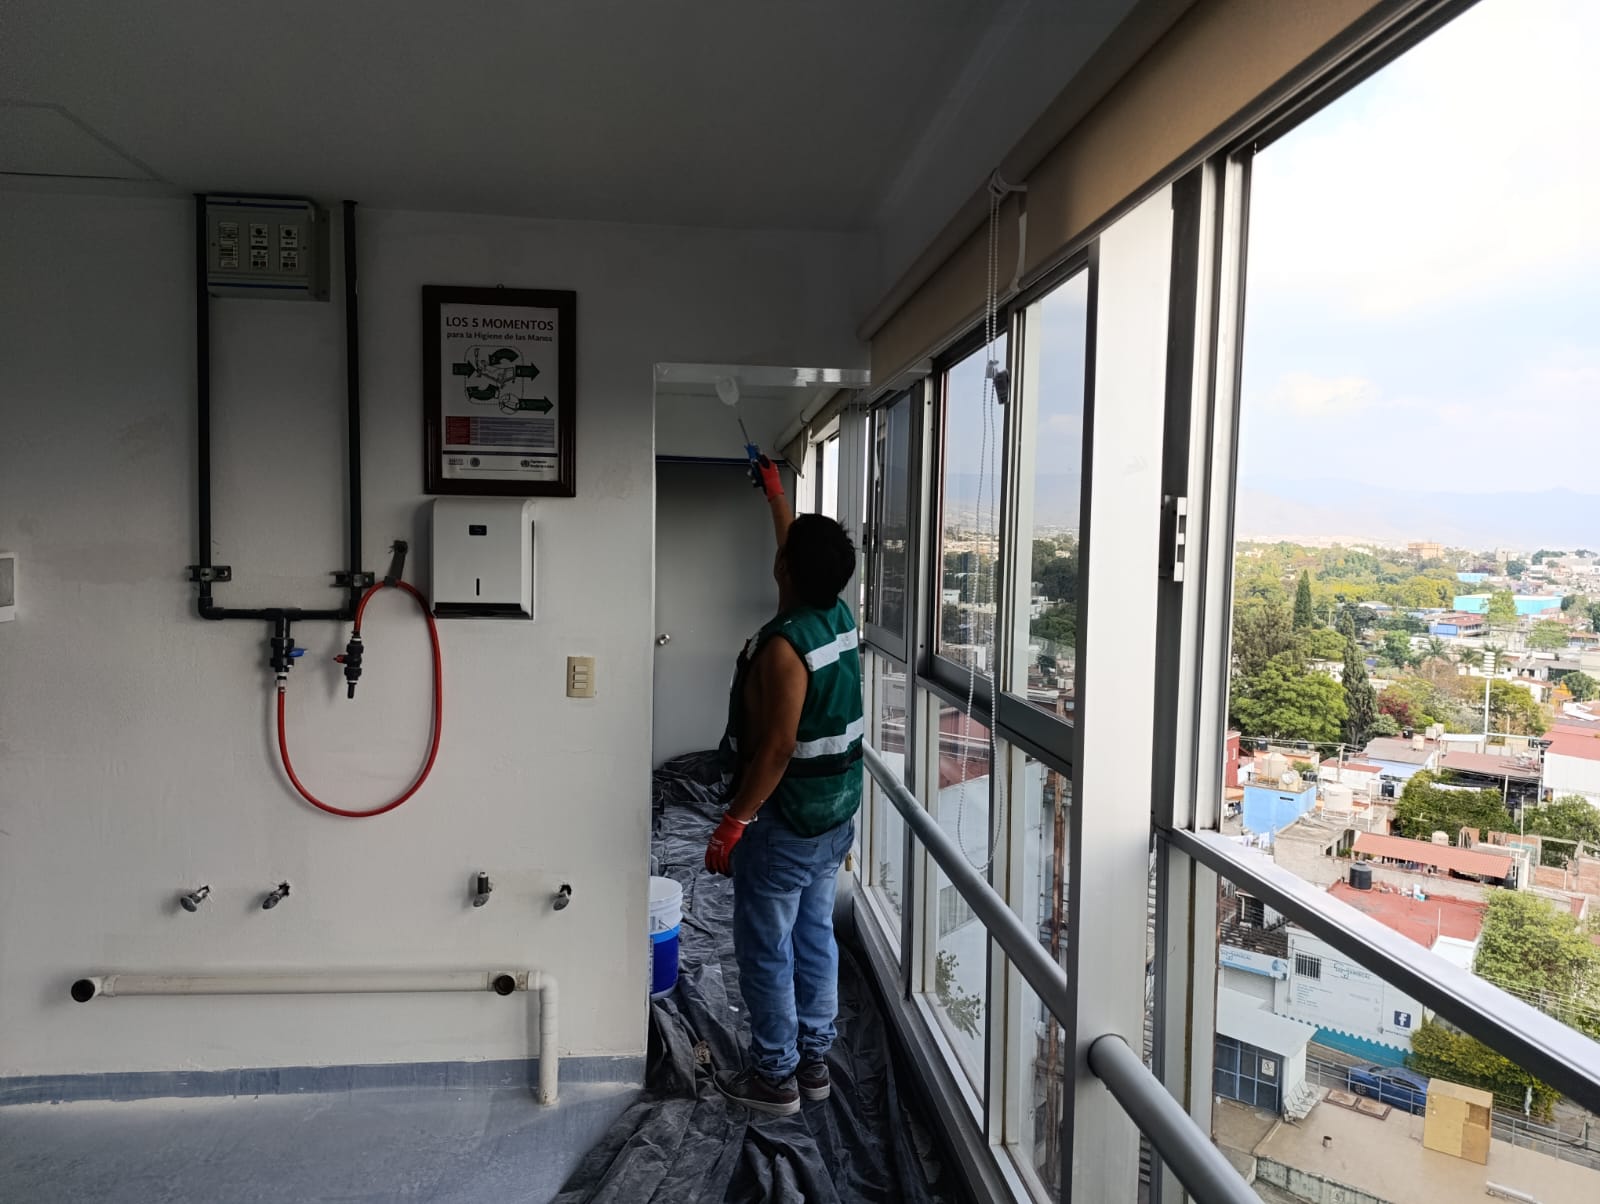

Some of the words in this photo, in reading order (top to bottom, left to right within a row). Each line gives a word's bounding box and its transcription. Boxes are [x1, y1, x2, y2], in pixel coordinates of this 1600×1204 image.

[446, 316, 468, 328] LOS
[472, 317, 479, 328] 5
[482, 318, 554, 331] MOMENTOS
[447, 332, 464, 340] para
[474, 332, 502, 341] Higiene
[528, 334, 552, 342] Manos
